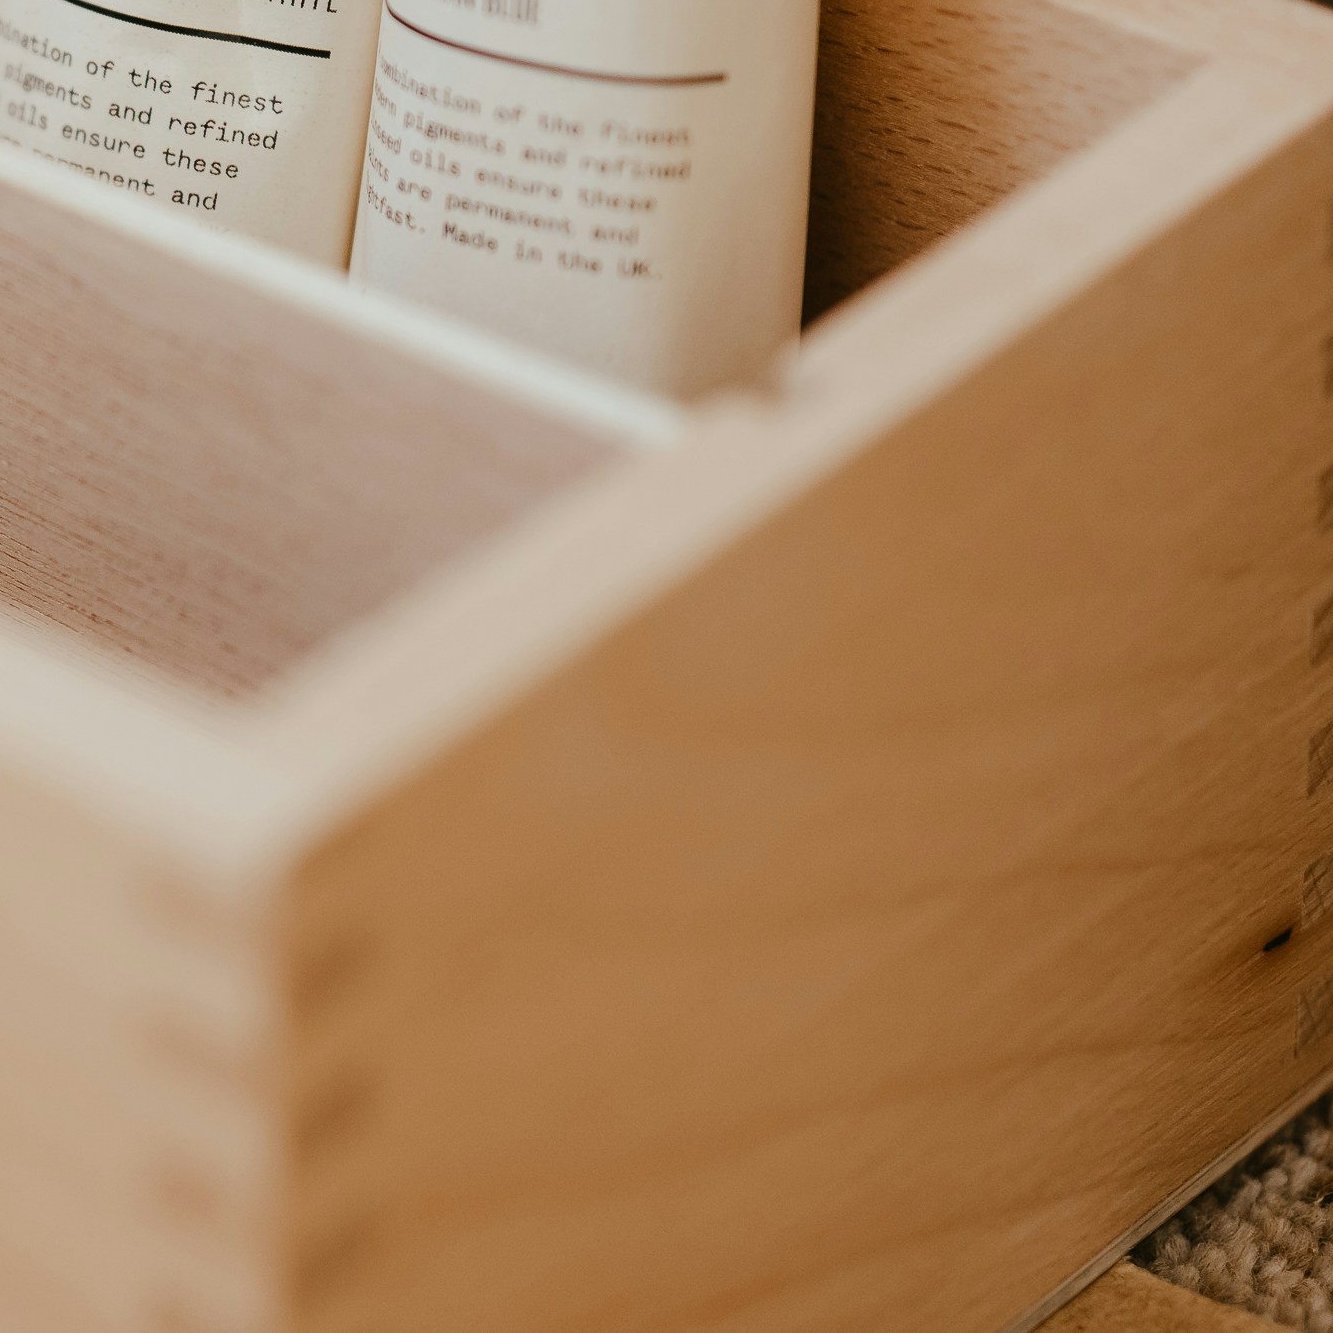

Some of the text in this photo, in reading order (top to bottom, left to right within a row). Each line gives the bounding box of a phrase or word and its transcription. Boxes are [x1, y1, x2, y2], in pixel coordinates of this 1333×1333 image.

[4, 62, 93, 111] pigments
[108, 102, 153, 125] and
[168, 116, 279, 150] refined
[86, 60, 115, 79] of
[129, 68, 173, 95] the
[191, 81, 284, 115] finest
[7, 100, 49, 131] oils
[61, 124, 146, 159] ensure
[162, 147, 240, 179] these
[409, 147, 462, 177] oils
[171, 188, 219, 211] and
